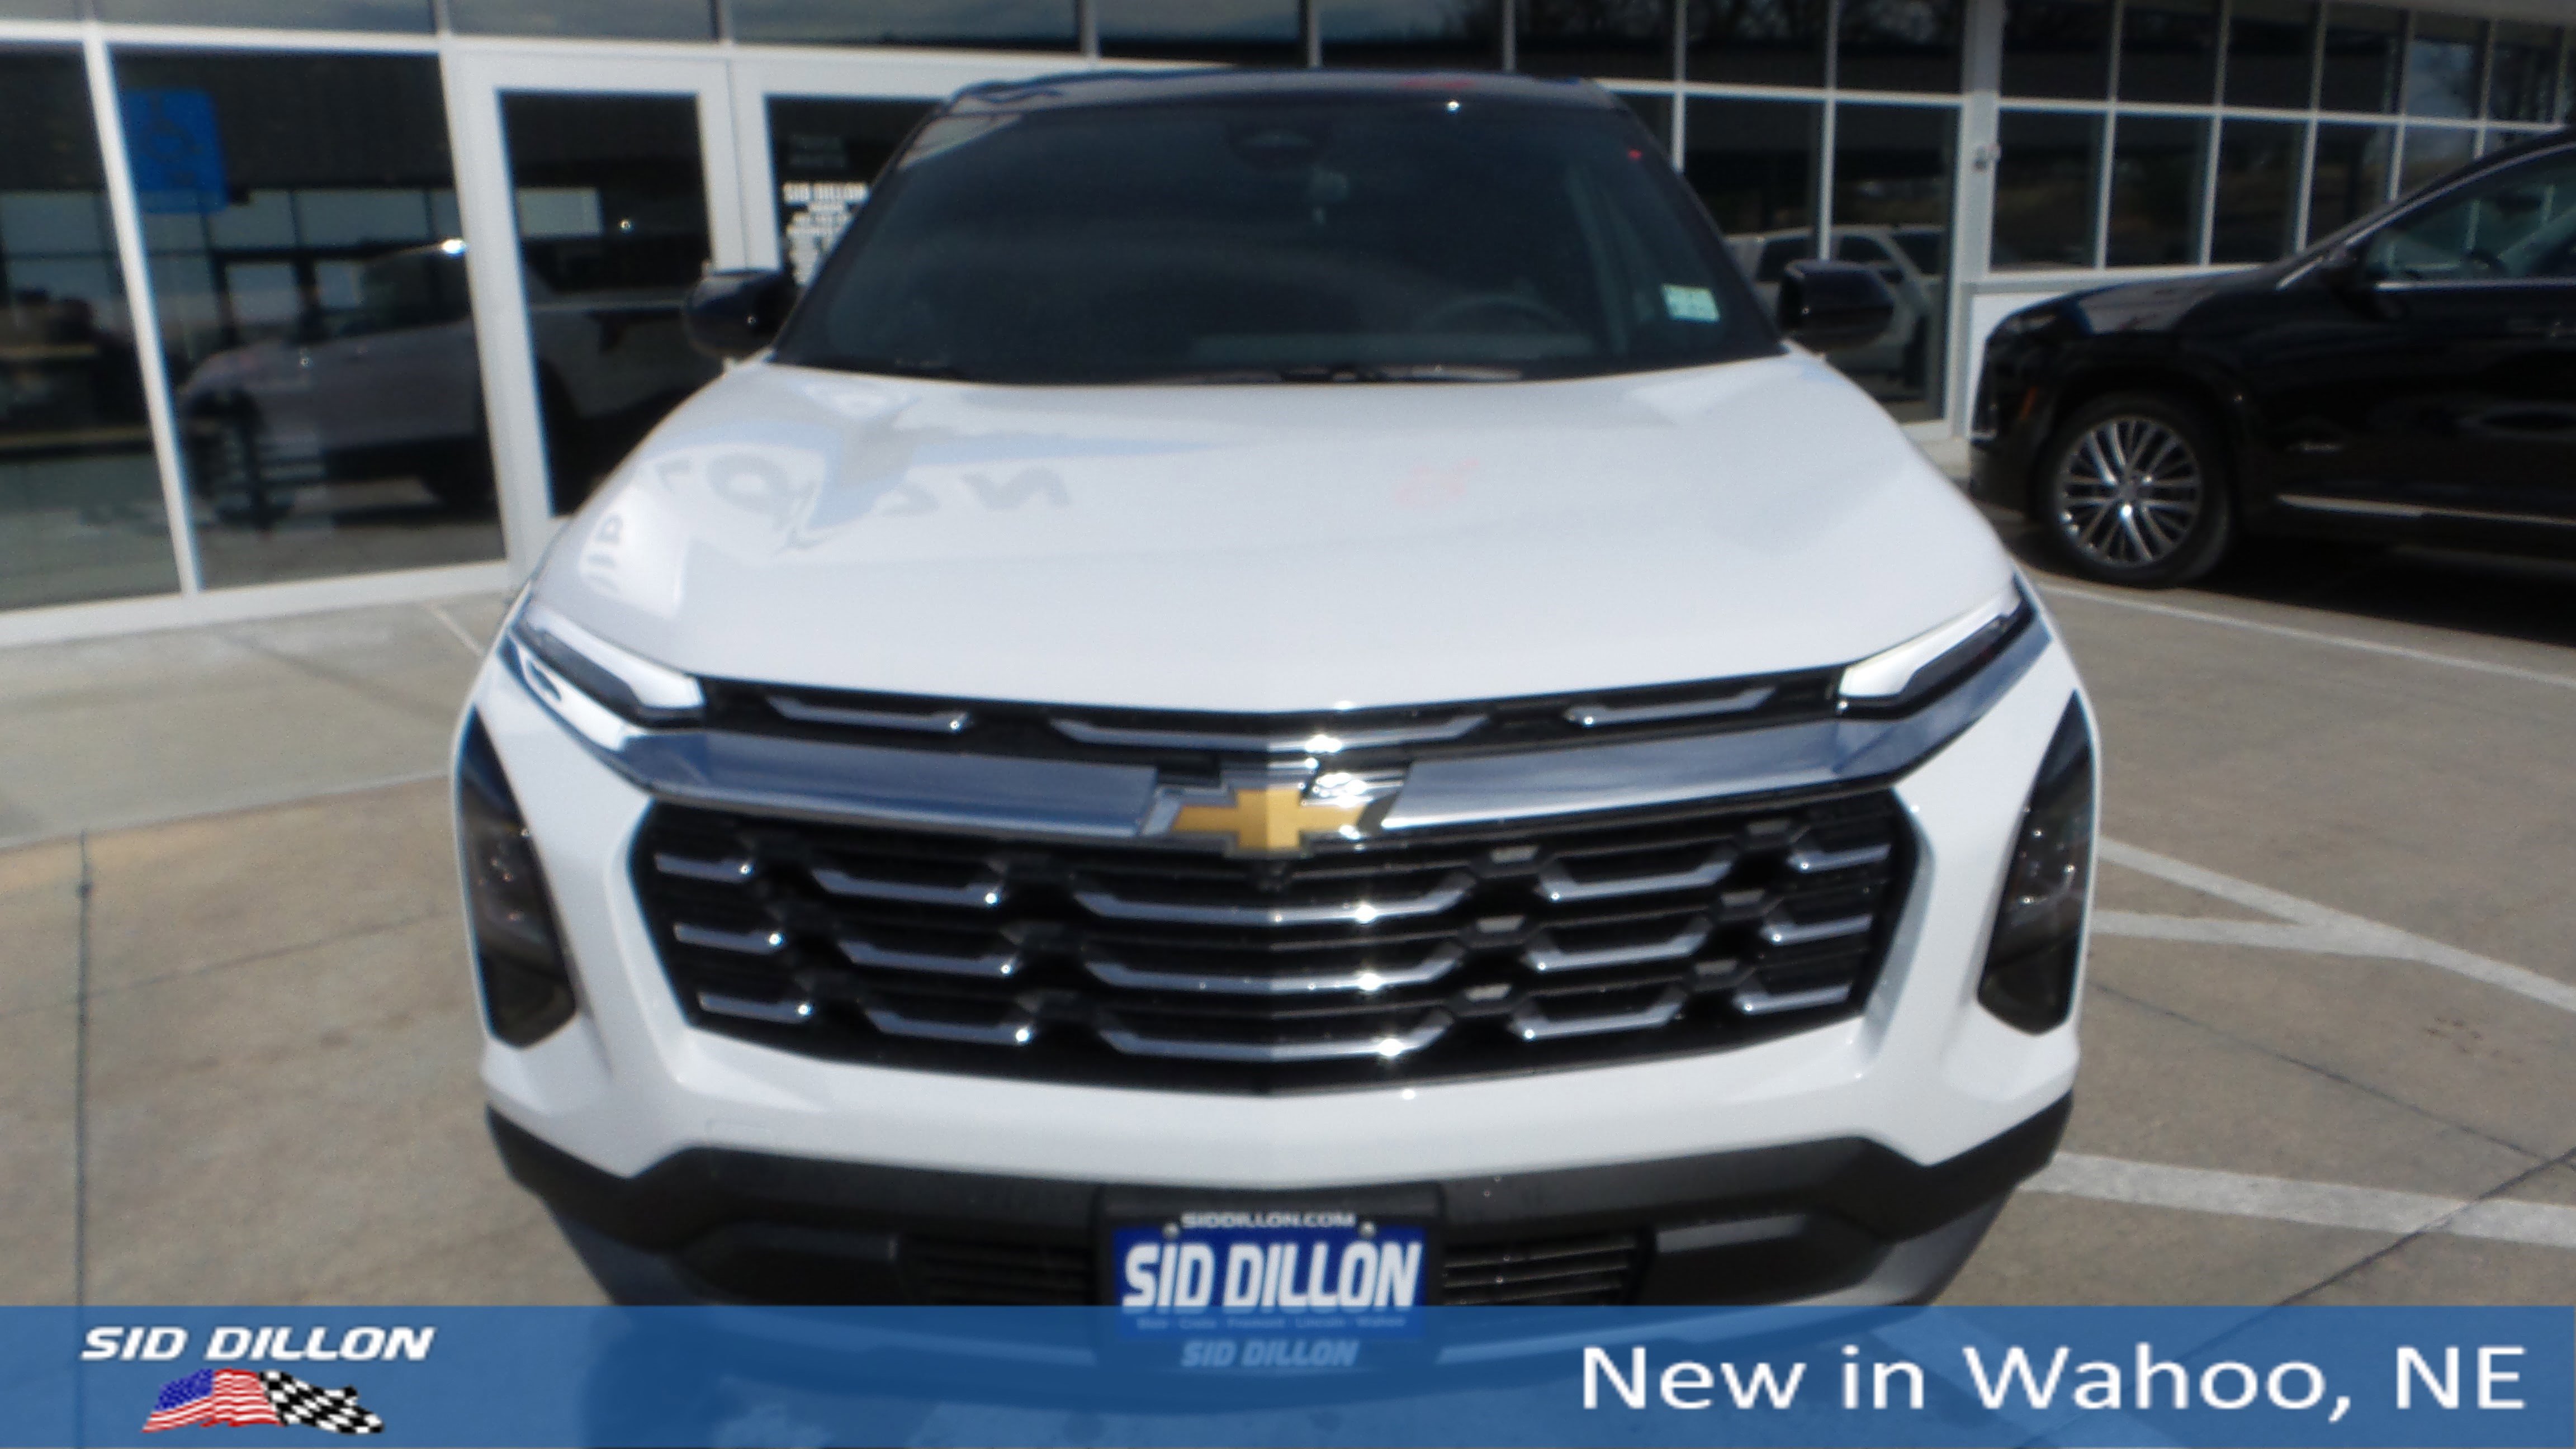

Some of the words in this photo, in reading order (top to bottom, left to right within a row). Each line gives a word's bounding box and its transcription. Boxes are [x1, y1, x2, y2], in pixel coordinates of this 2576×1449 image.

[1123, 1242, 1215, 1314] SID
[1223, 1241, 1422, 1314] DILLON
[1181, 1341, 1235, 1367] SID
[1240, 1340, 1360, 1367] DILLON
